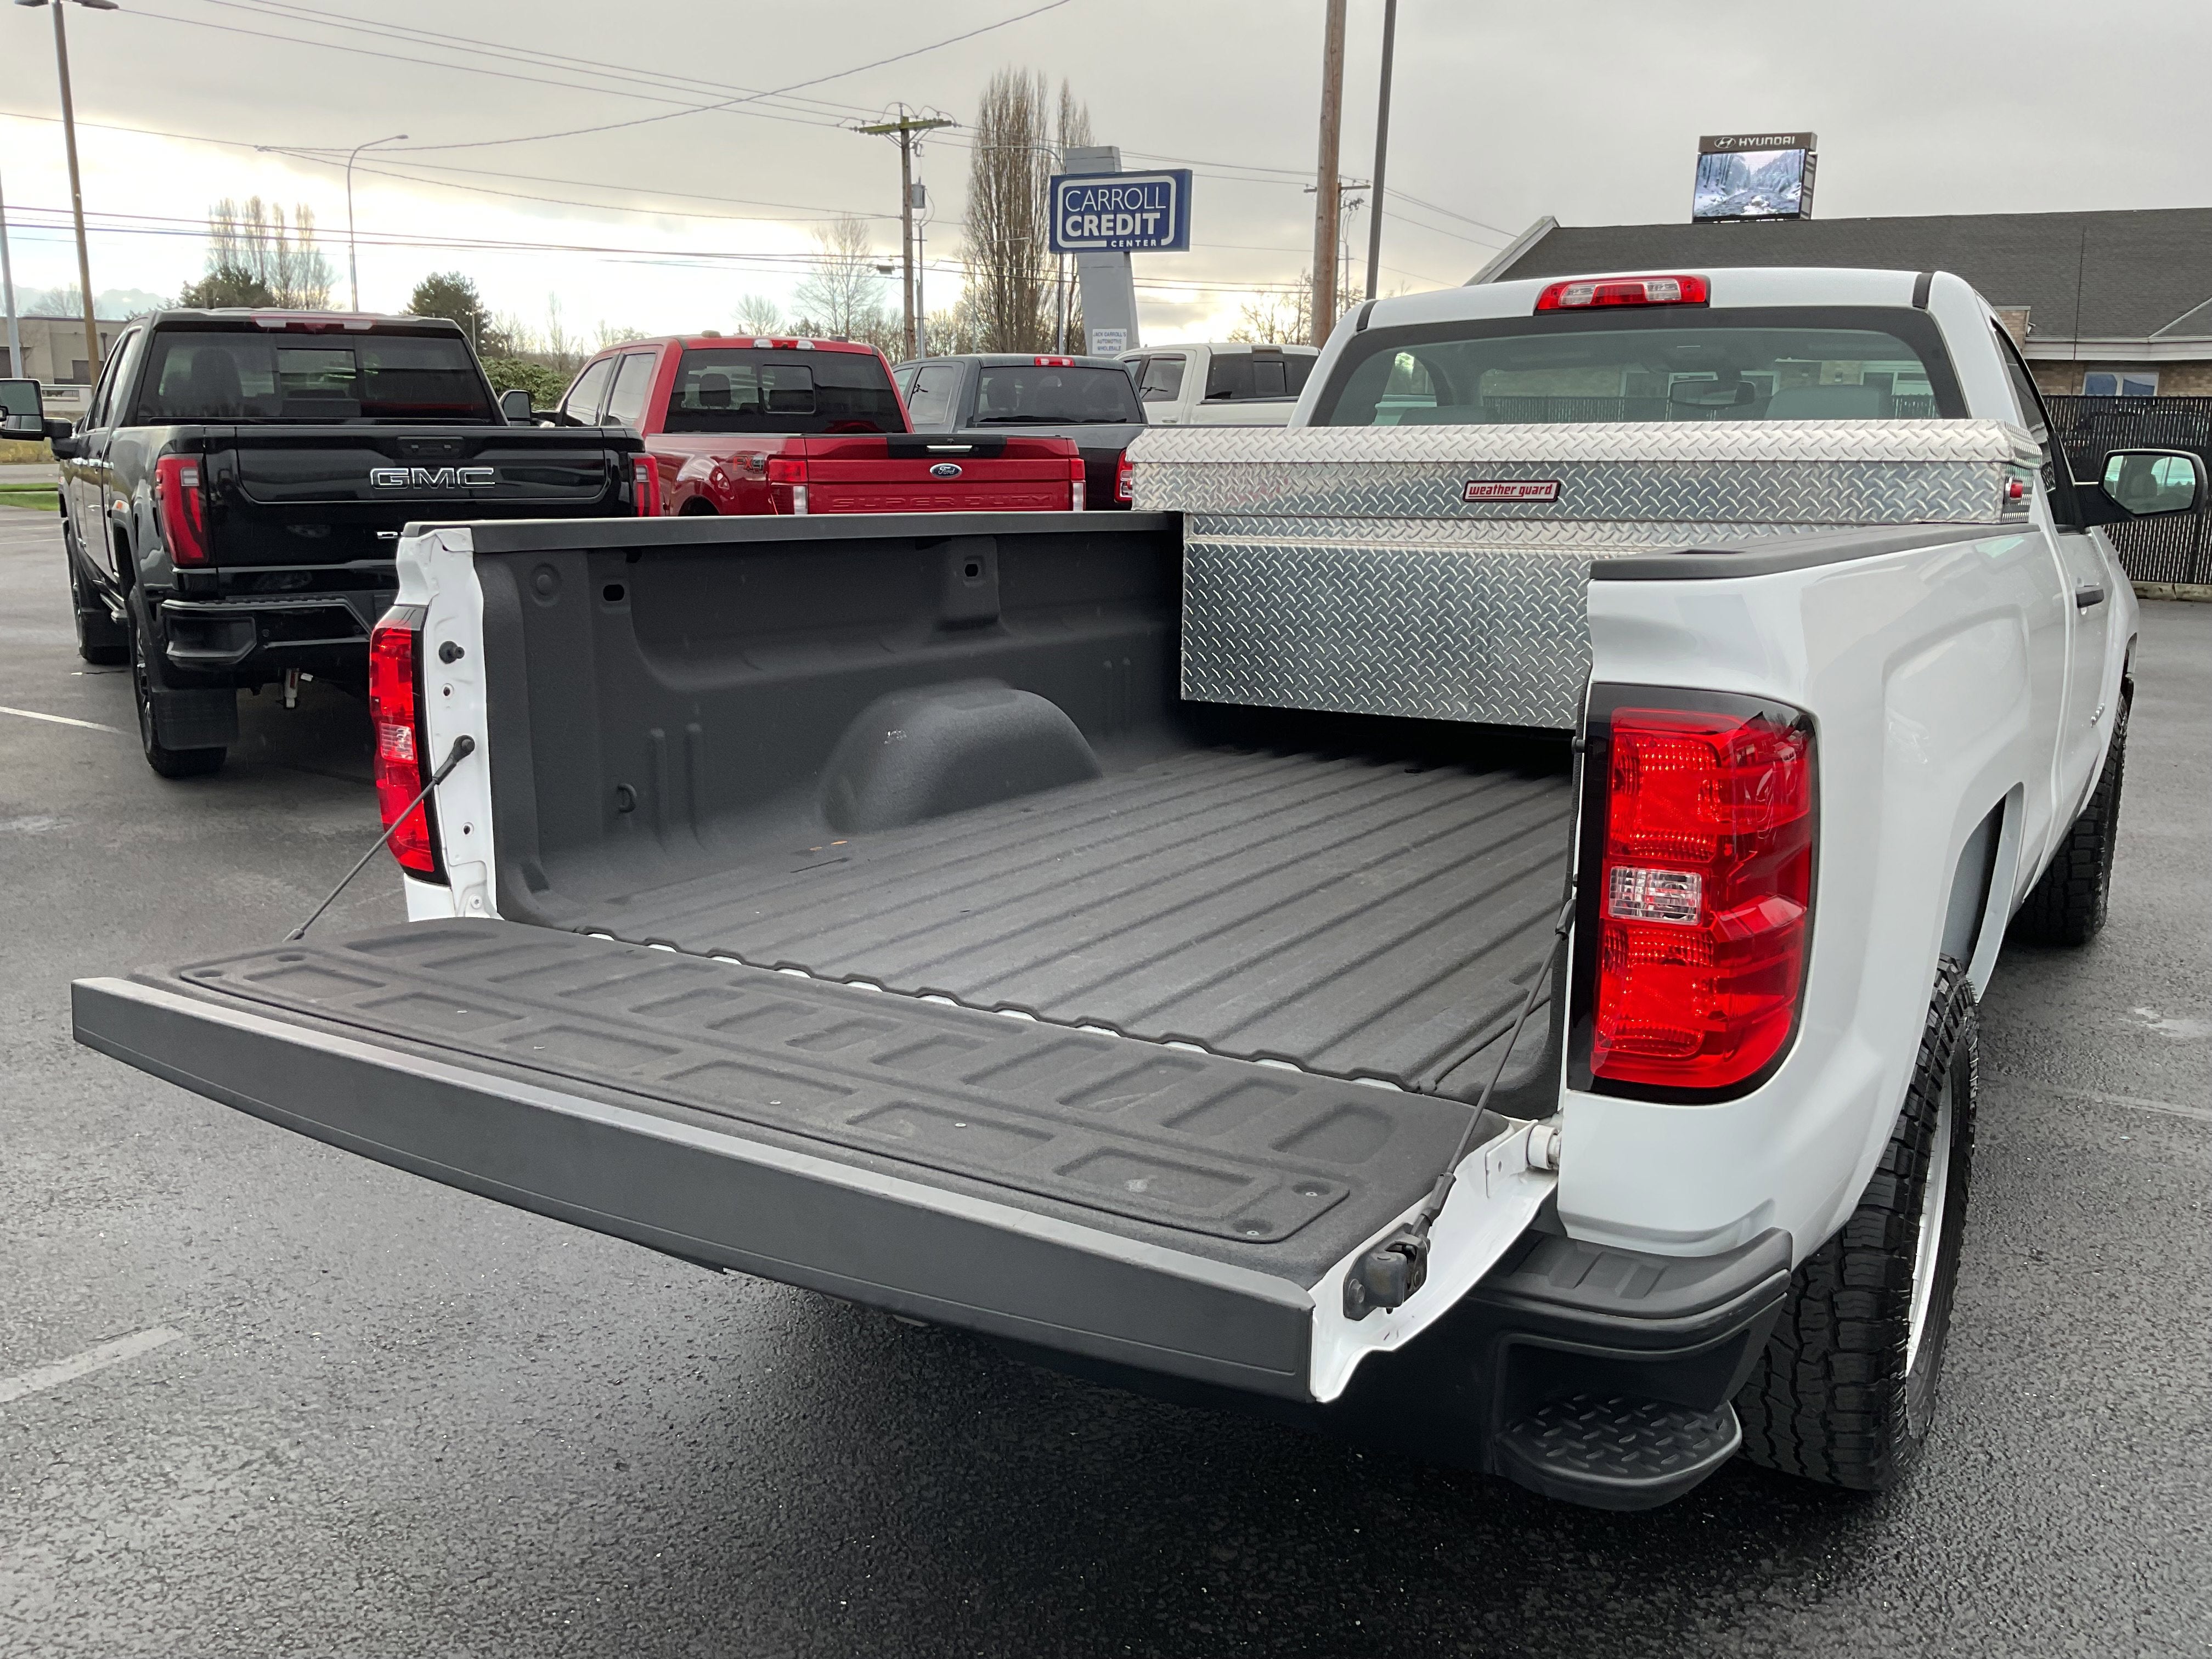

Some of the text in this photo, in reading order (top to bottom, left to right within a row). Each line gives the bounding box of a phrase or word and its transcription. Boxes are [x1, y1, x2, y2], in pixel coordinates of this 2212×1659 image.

[1739, 136, 1795, 146] HYUNDAI
[1065, 187, 1166, 212] CARROLL
[1065, 212, 1161, 237] CREDIT
[1111, 239, 1157, 247] CENTER
[733, 455, 764, 471] FX4
[938, 466, 955, 475] Ford
[370, 467, 495, 489] GMC
[1469, 484, 1553, 497] weather guard
[832, 495, 1049, 507] SUPER DUTY
